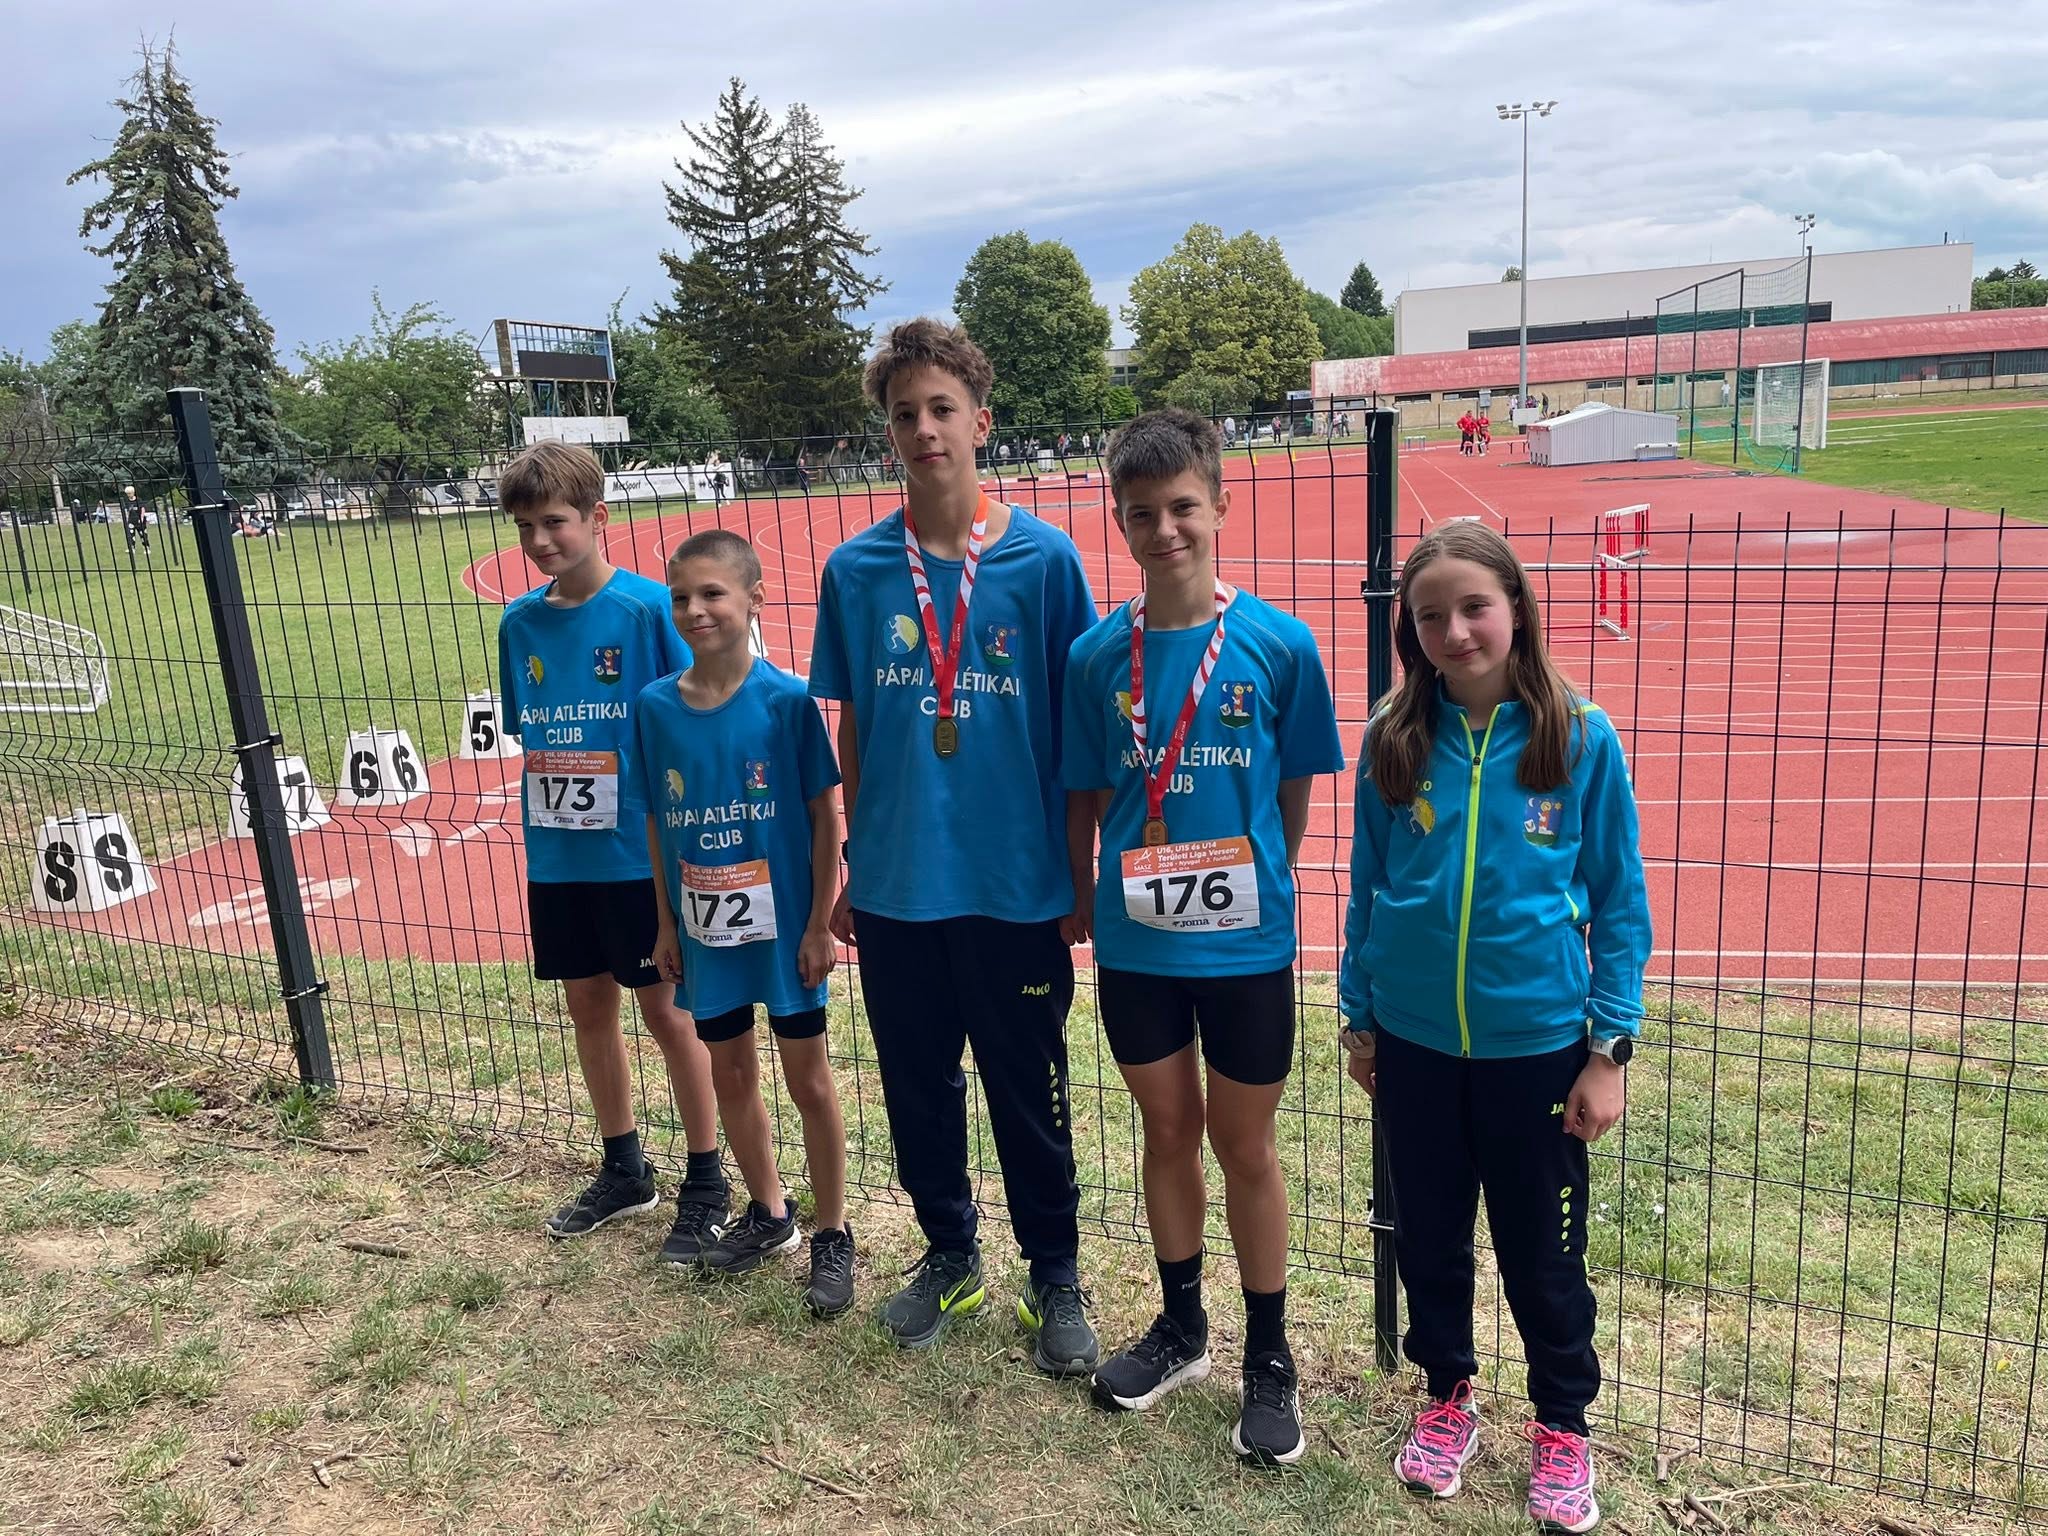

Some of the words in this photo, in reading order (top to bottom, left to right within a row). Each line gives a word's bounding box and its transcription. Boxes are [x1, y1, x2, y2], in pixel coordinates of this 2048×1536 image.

[876, 662, 924, 687] PÁPAI
[553, 699, 627, 723] ATLÉTIKAI
[471, 711, 494, 752] 5
[546, 727, 583, 745] CLUB
[350, 750, 379, 799] 6
[392, 744, 417, 792] 6
[283, 771, 307, 822] 7
[539, 776, 596, 812] 173
[665, 806, 700, 828] PÁPAI
[702, 799, 776, 825] ATLÉTIKAI
[699, 828, 743, 851] CLUB
[1156, 846, 1173, 855] U16,
[1202, 841, 1217, 849] U14
[1157, 852, 1188, 863] Területi
[1189, 850, 1207, 860] Liga
[1209, 847, 1240, 858] Verseny
[45, 841, 78, 902] 8
[95, 832, 133, 893] 8
[729, 869, 757, 880] Verseny
[1144, 871, 1234, 916] 176
[688, 891, 753, 929] 172
[1021, 982, 1050, 996] JAKO
